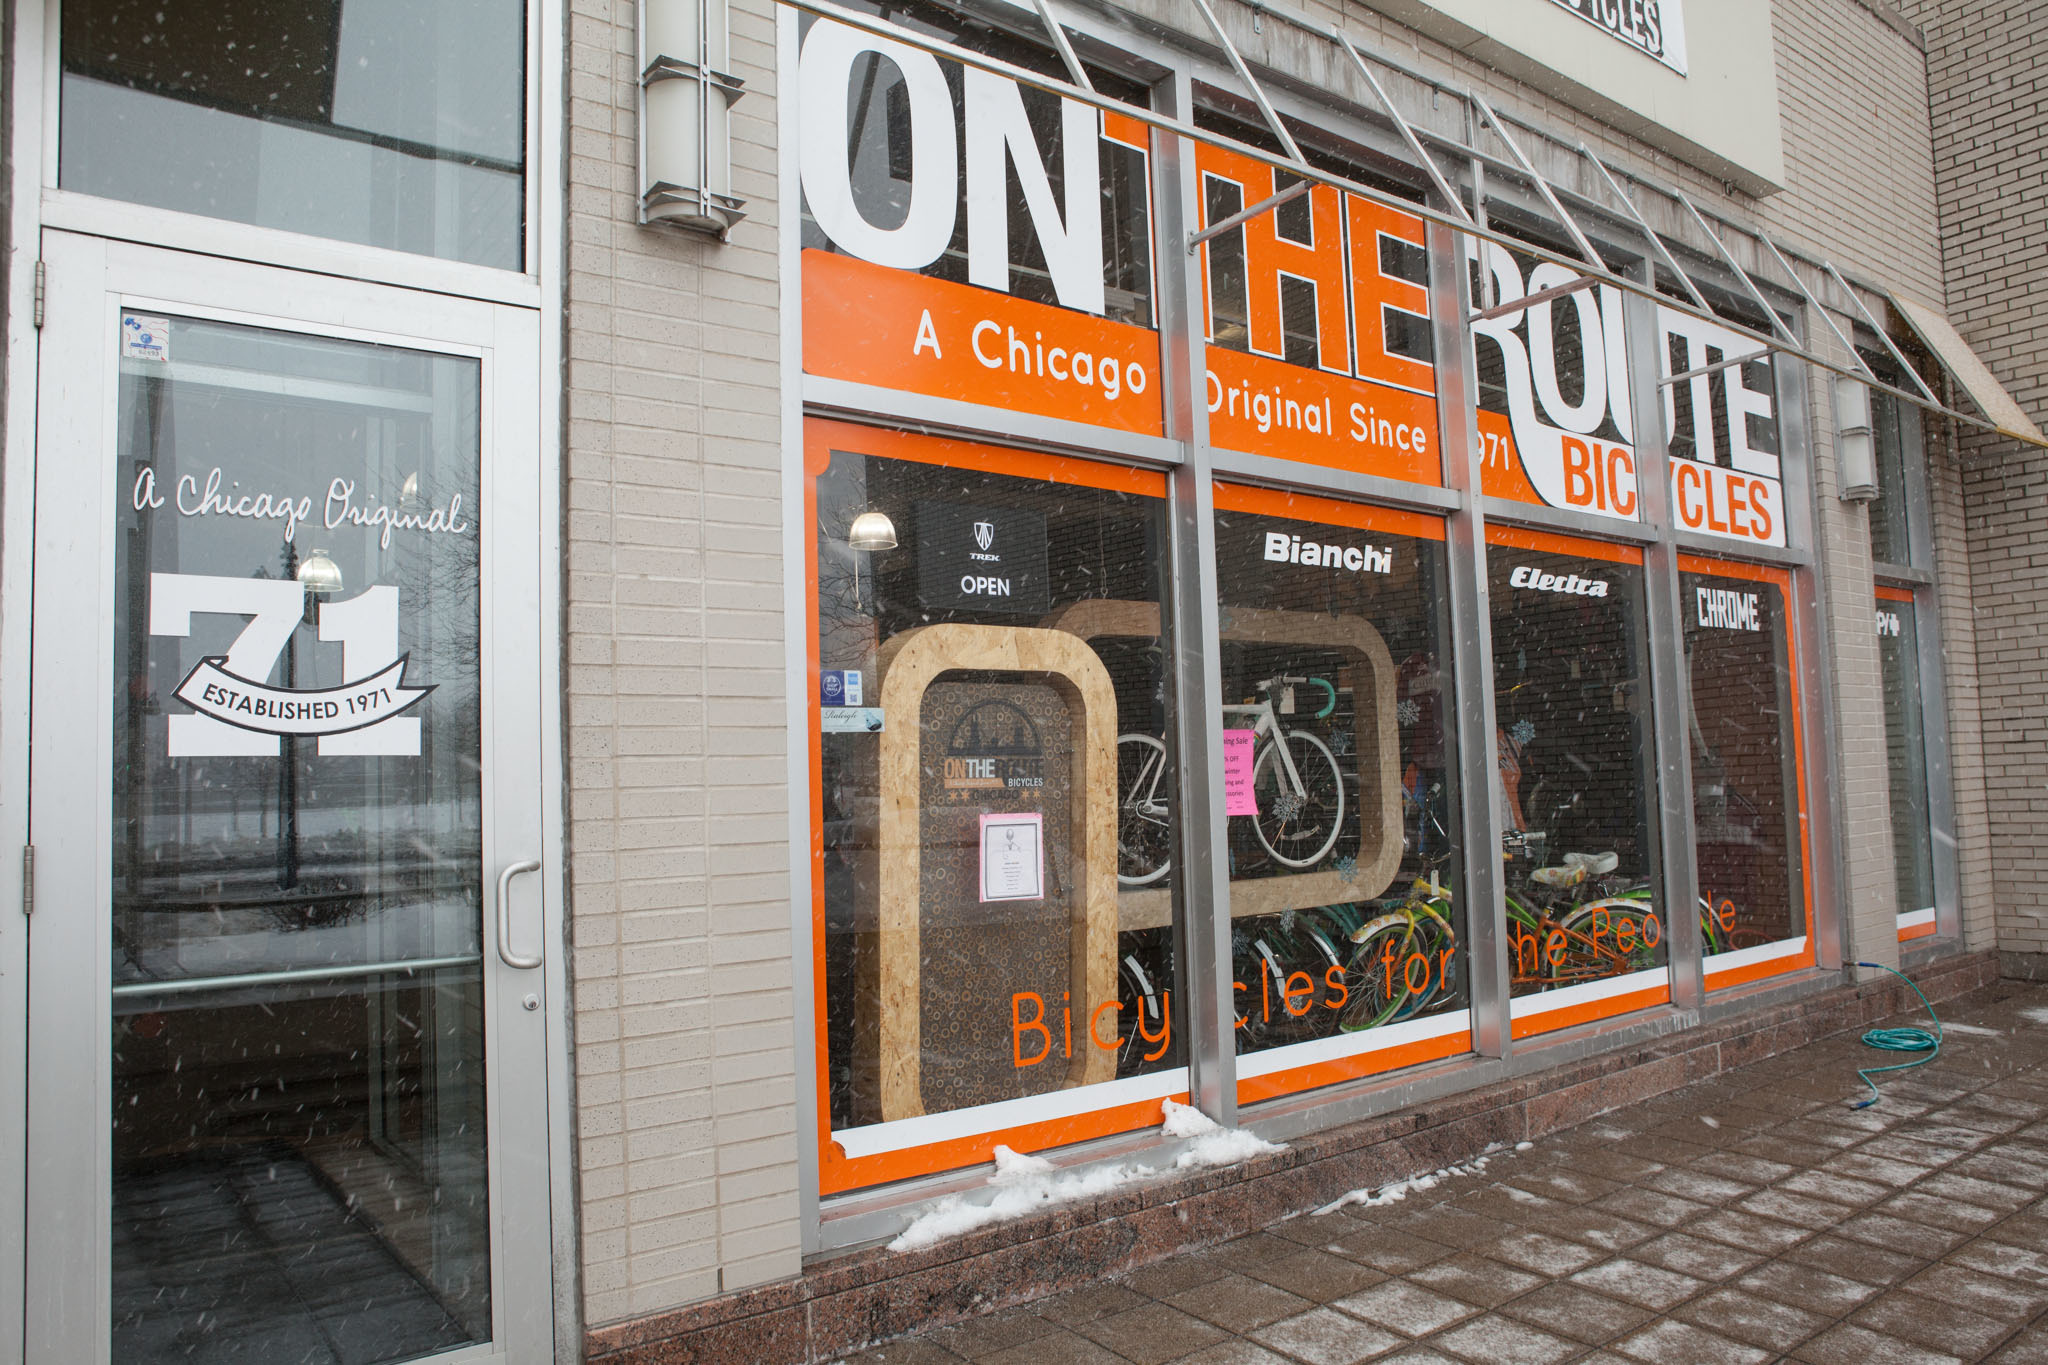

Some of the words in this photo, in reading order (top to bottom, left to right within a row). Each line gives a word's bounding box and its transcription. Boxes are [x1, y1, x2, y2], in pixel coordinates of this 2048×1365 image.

[800, 10, 1105, 316] ON
[913, 309, 942, 361] A
[971, 320, 1147, 401] Chicago
[1206, 369, 1332, 436] Original
[1350, 402, 1427, 454] Since
[1477, 429, 1509, 471] 971
[1561, 434, 1773, 541] BICCLES
[134, 467, 164, 510] A
[177, 467, 312, 543] Chicago
[324, 476, 468, 550] Original
[969, 552, 1001, 562] TREK
[1263, 532, 1392, 575] Bianchi
[960, 575, 1011, 597] OPEN
[1510, 566, 1609, 598] Electra
[1696, 587, 1760, 631] CHROME
[149, 571, 422, 758] 71
[202, 683, 339, 720] ESTABLISHED
[346, 687, 392, 715] 1971
[824, 710, 857, 724] Raleigh
[1236, 736, 1249, 745] Sale
[944, 758, 966, 779] ON
[966, 758, 996, 779] THE
[1008, 777, 1044, 788] BICYCLES
[1380, 939, 1456, 1000] for
[1516, 920, 1568, 975] he
[1591, 889, 1737, 960] Peole
